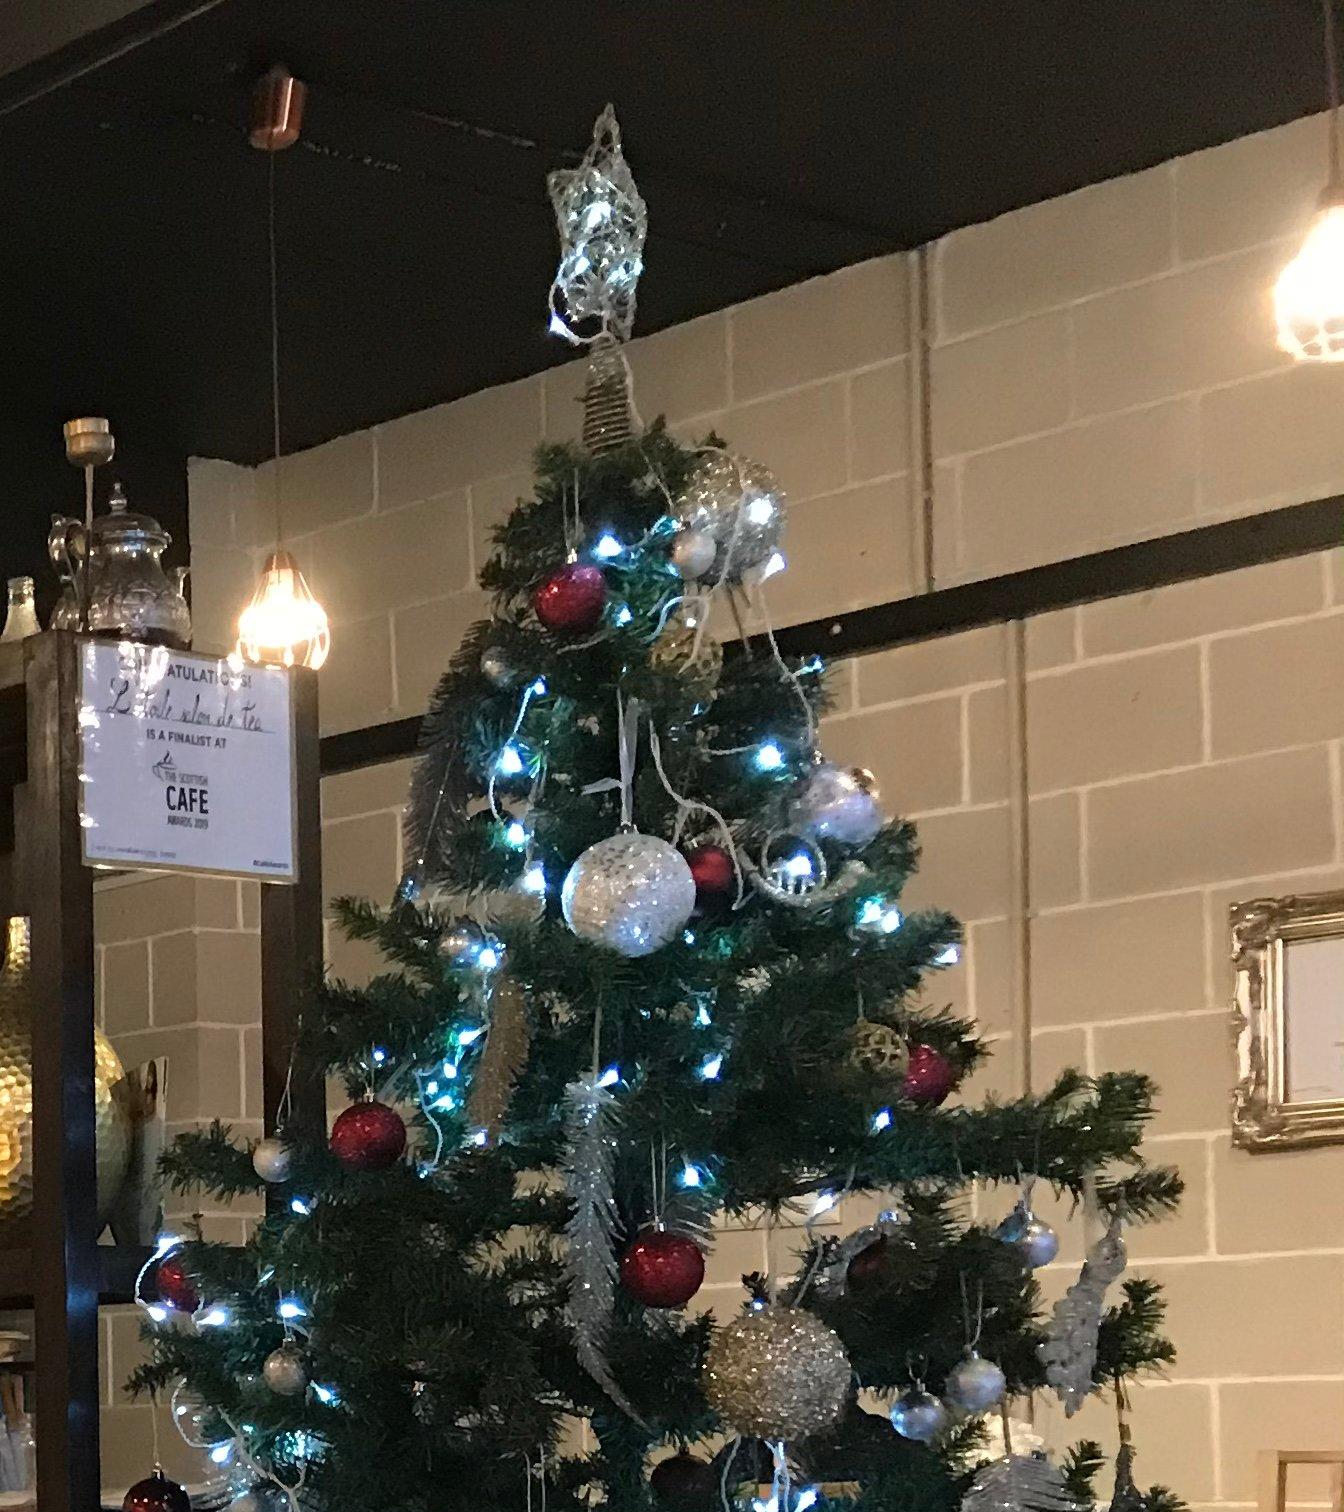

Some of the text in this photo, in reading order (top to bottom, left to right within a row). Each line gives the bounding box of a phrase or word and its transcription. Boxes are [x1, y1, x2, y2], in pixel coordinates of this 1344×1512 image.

[146, 728, 227, 749] IS A FINALIST AT
[164, 770, 208, 786] THE SCOTTISH
[166, 785, 209, 815] CAFE
